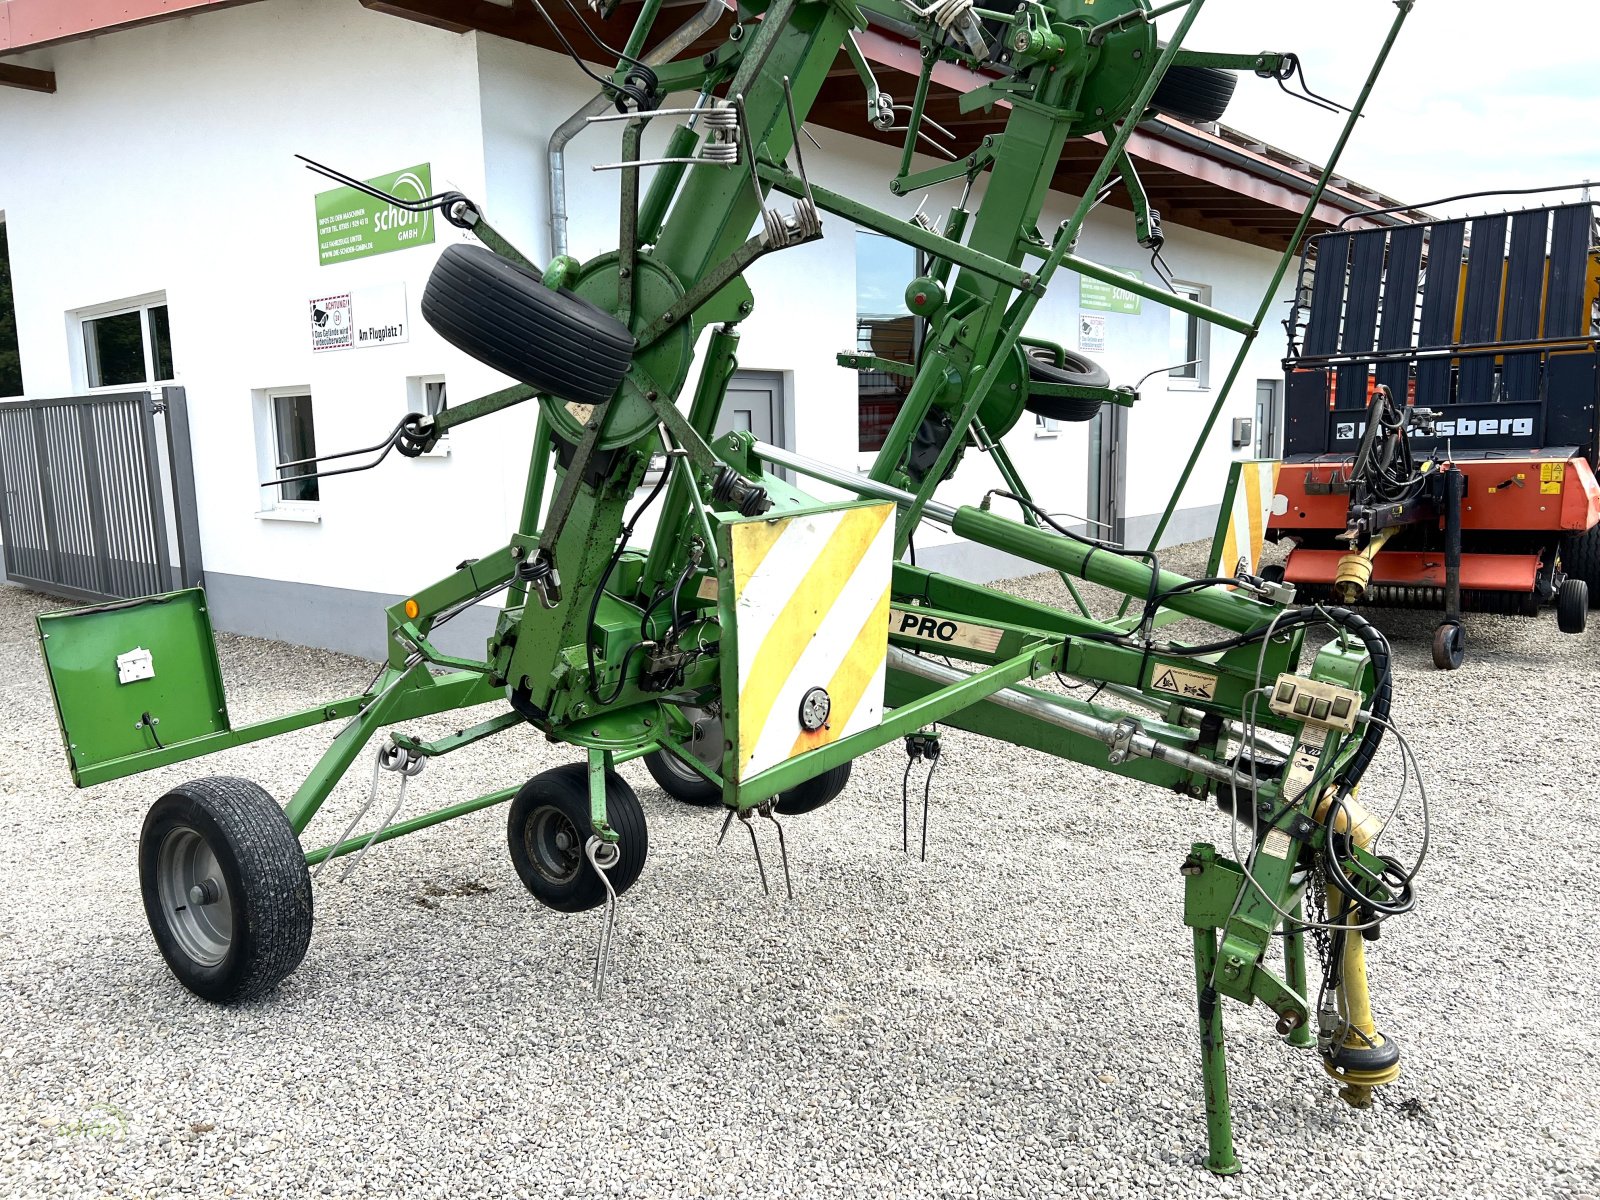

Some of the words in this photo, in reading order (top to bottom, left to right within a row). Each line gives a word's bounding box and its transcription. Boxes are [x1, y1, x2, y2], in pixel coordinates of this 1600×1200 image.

[343, 208, 365, 219] MASCHINEN
[320, 227, 331, 235] UNTER
[398, 228, 418, 240] GMBH
[323, 328, 339, 336] Gelände
[340, 326, 348, 335] wird
[359, 328, 368, 341] Am
[369, 325, 398, 342] Flugplatz
[399, 324, 403, 336] 7
